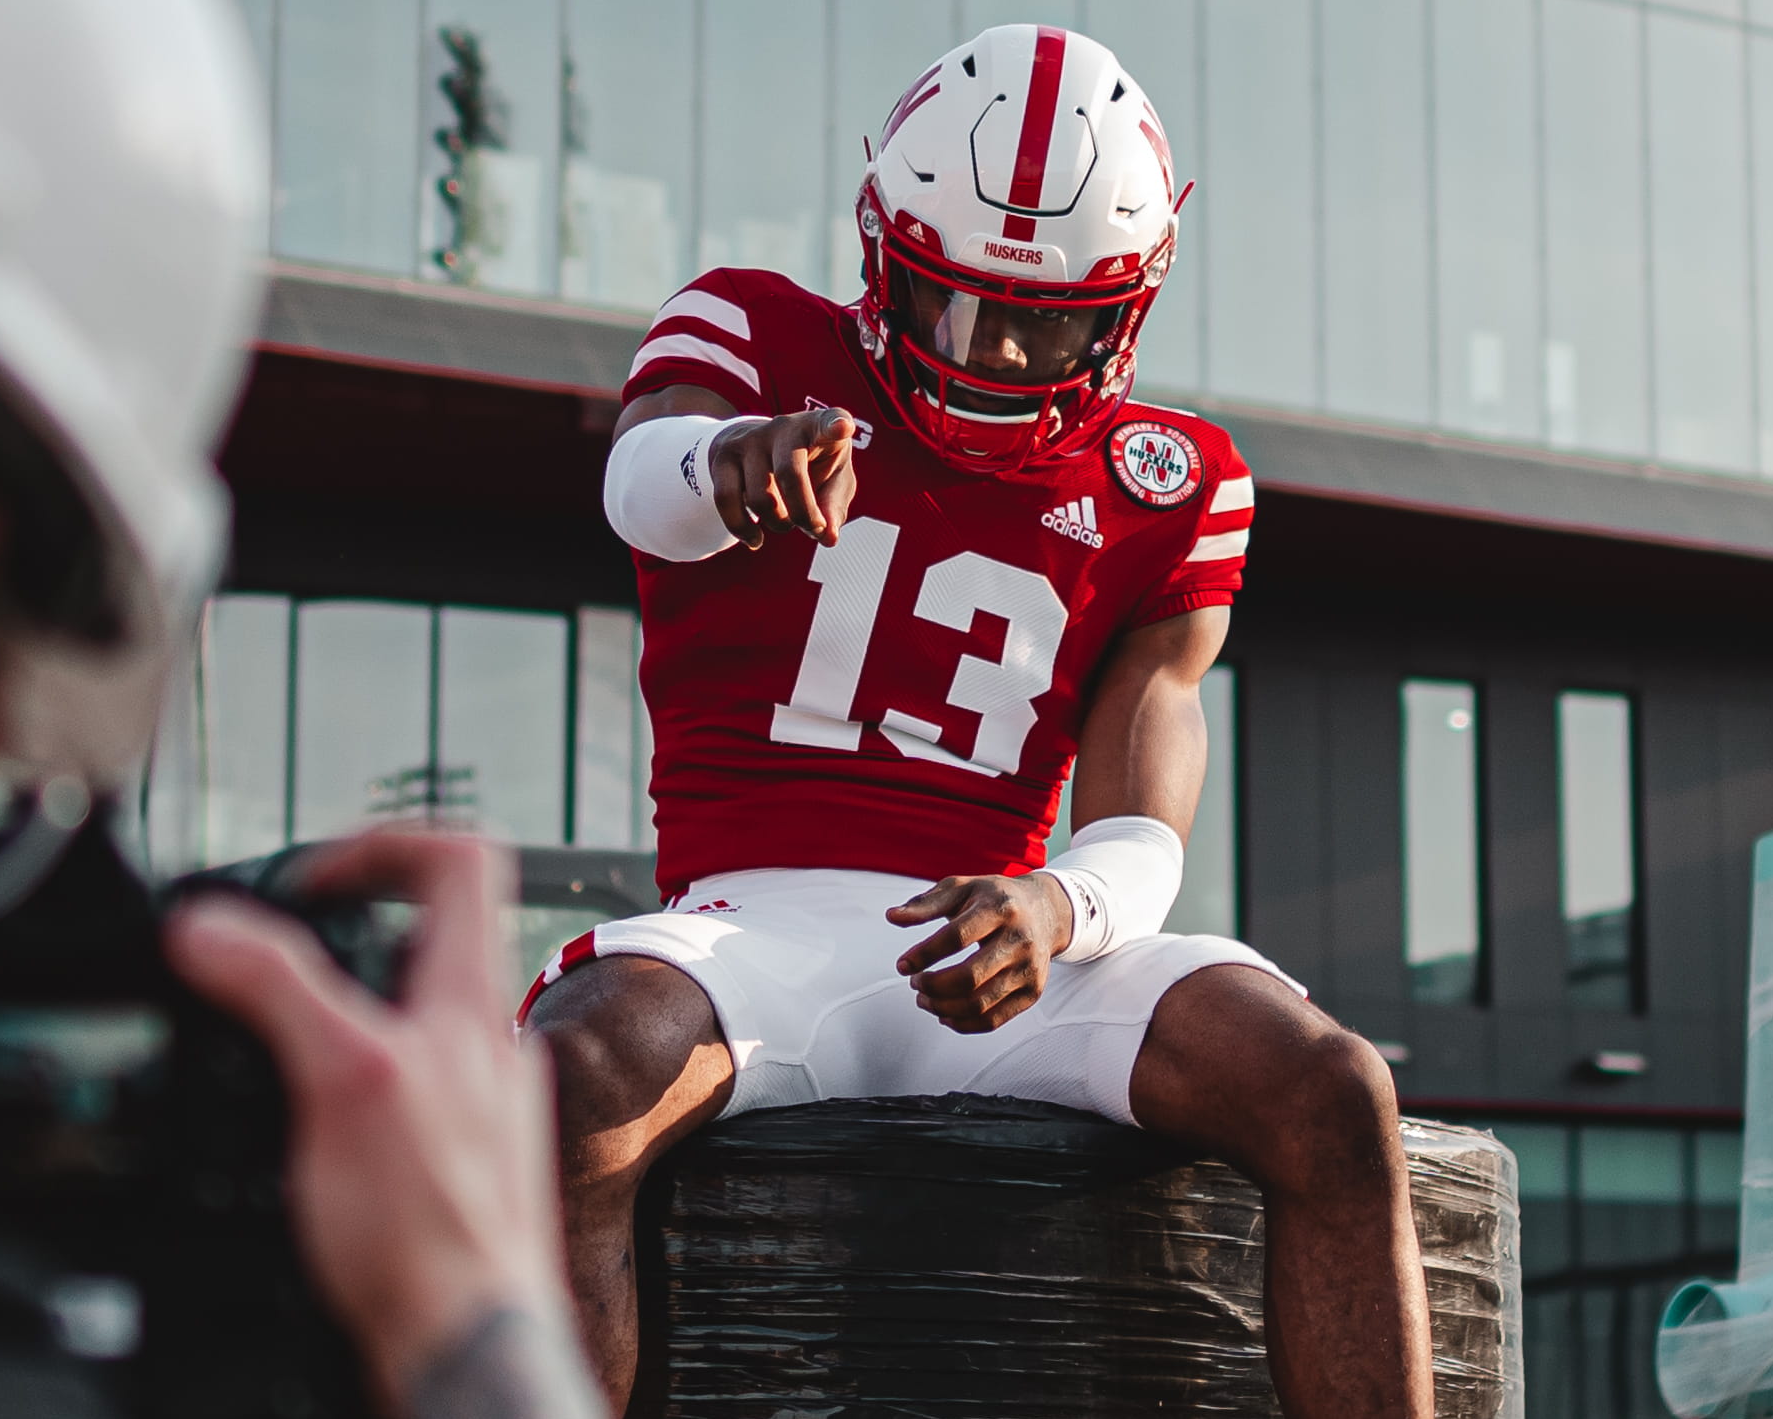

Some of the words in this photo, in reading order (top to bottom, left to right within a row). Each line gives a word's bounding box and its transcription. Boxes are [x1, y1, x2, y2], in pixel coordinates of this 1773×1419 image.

[984, 242, 1043, 265] HUSKERS
[1128, 446, 1183, 475] HUSKERS
[1151, 478, 1196, 504] TRADITION
[1041, 513, 1104, 549] adidas
[770, 516, 1069, 778] 13
